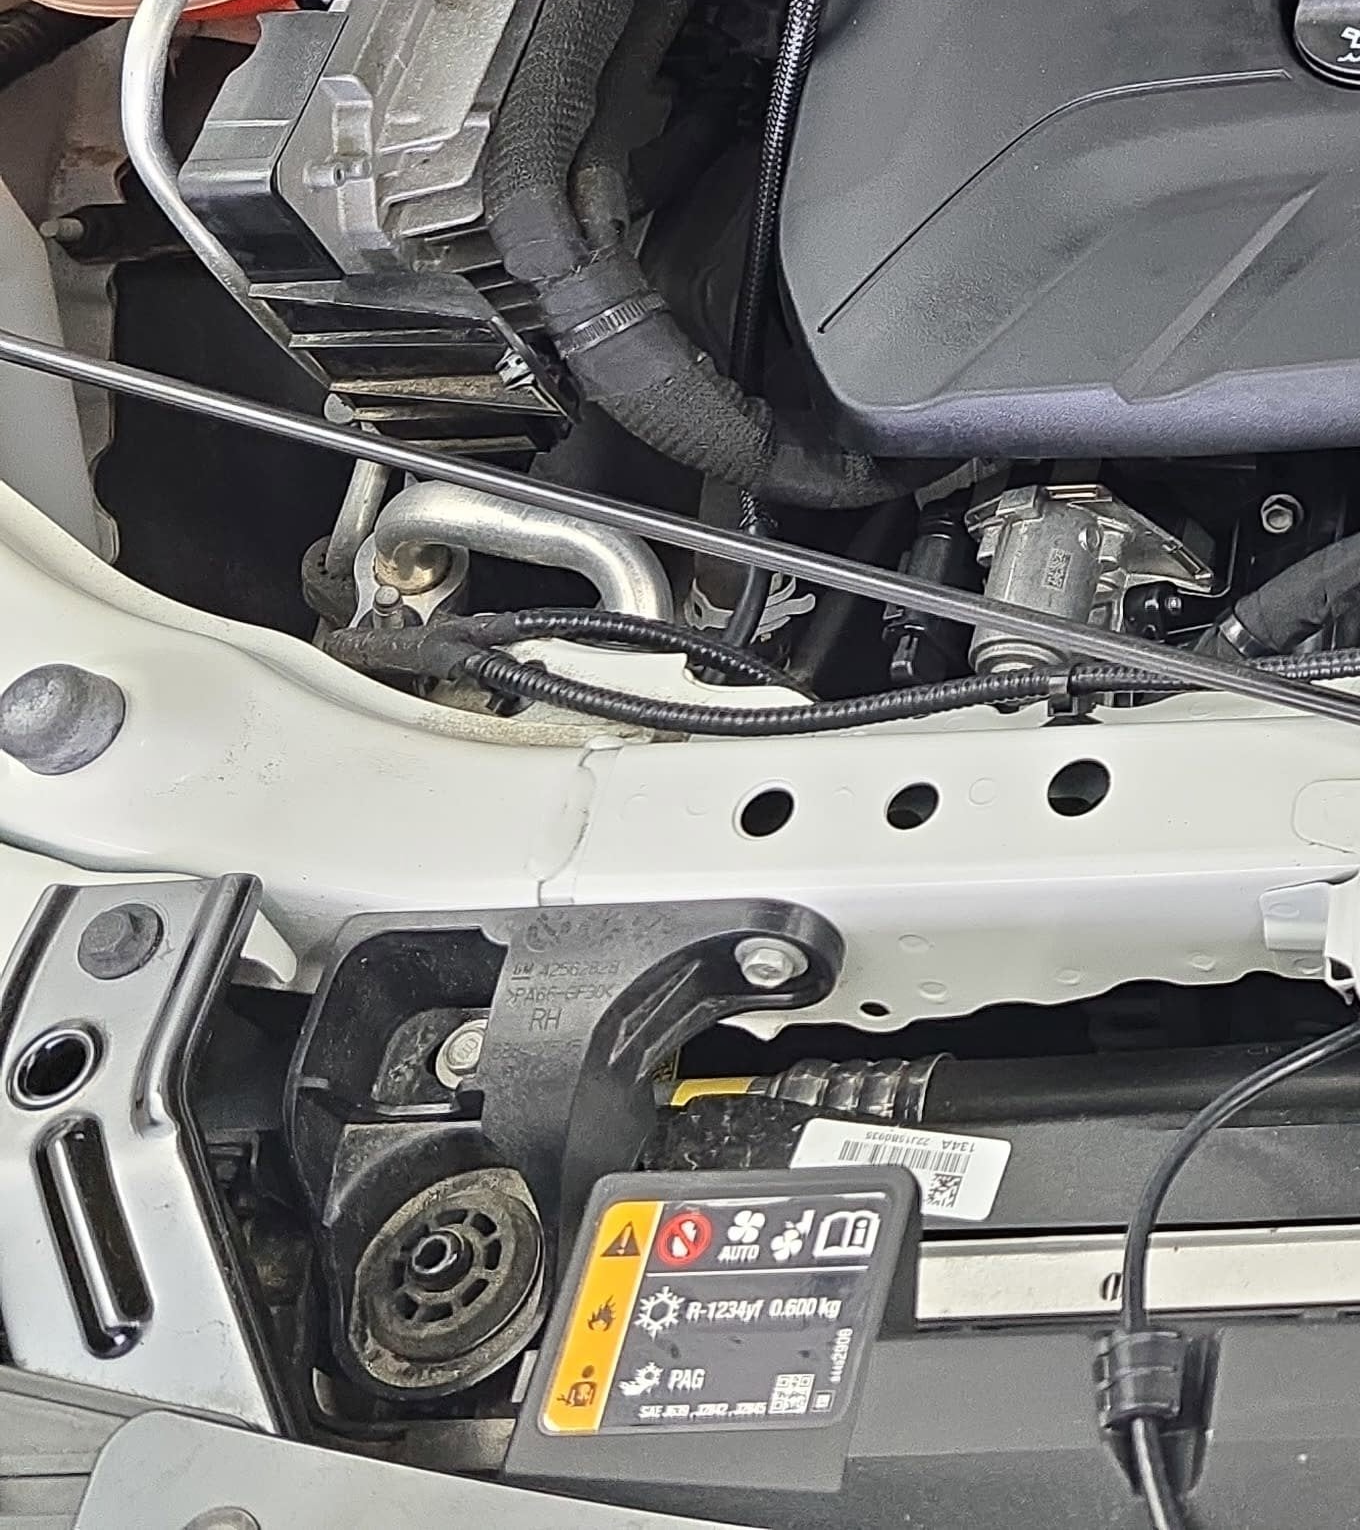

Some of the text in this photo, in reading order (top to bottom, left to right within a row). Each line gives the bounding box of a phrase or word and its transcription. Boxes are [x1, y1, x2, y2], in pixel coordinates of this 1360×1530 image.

[529, 1007, 563, 1031] RH
[942, 1139, 976, 1153] 134A
[717, 1244, 760, 1261] AUTO
[686, 1298, 842, 1321] R-1234yf 0.600 kg
[668, 1368, 705, 1390] PAG
[638, 1405, 663, 1418] SAE
